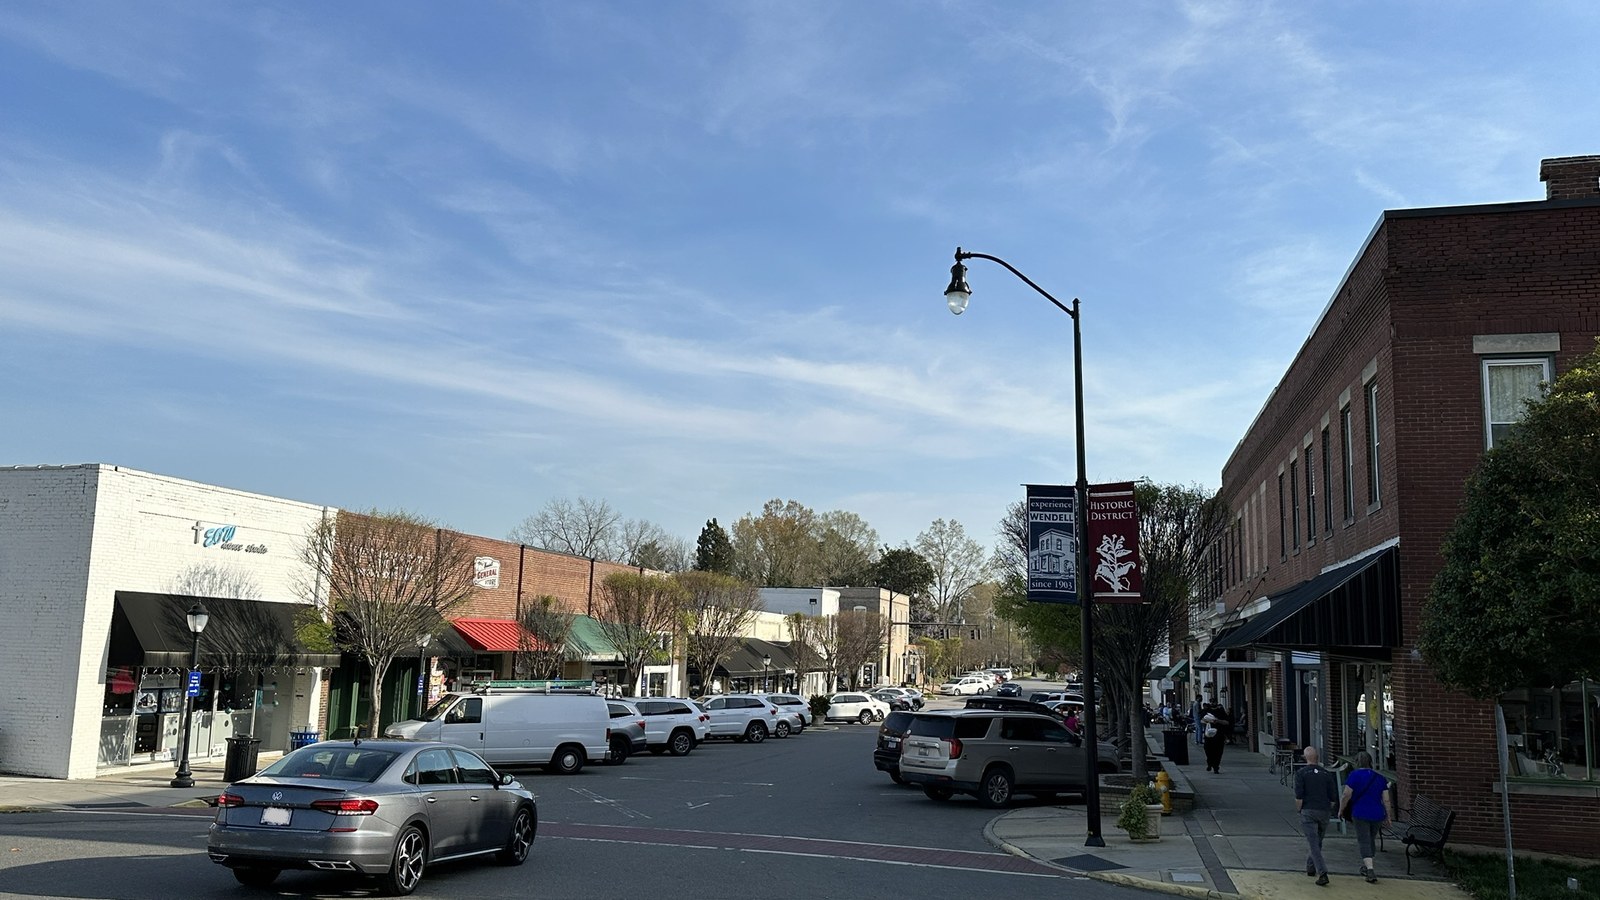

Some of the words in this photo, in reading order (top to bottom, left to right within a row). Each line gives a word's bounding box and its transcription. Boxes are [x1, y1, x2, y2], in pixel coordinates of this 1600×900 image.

[1030, 500, 1072, 509] experience
[1090, 501, 1134, 510] HISTORIC
[1029, 513, 1073, 521] WENDELL
[1091, 512, 1133, 520] DISTRICT
[477, 569, 497, 579] GENERAL
[1031, 580, 1052, 588] since
[1055, 580, 1073, 589] 1903
